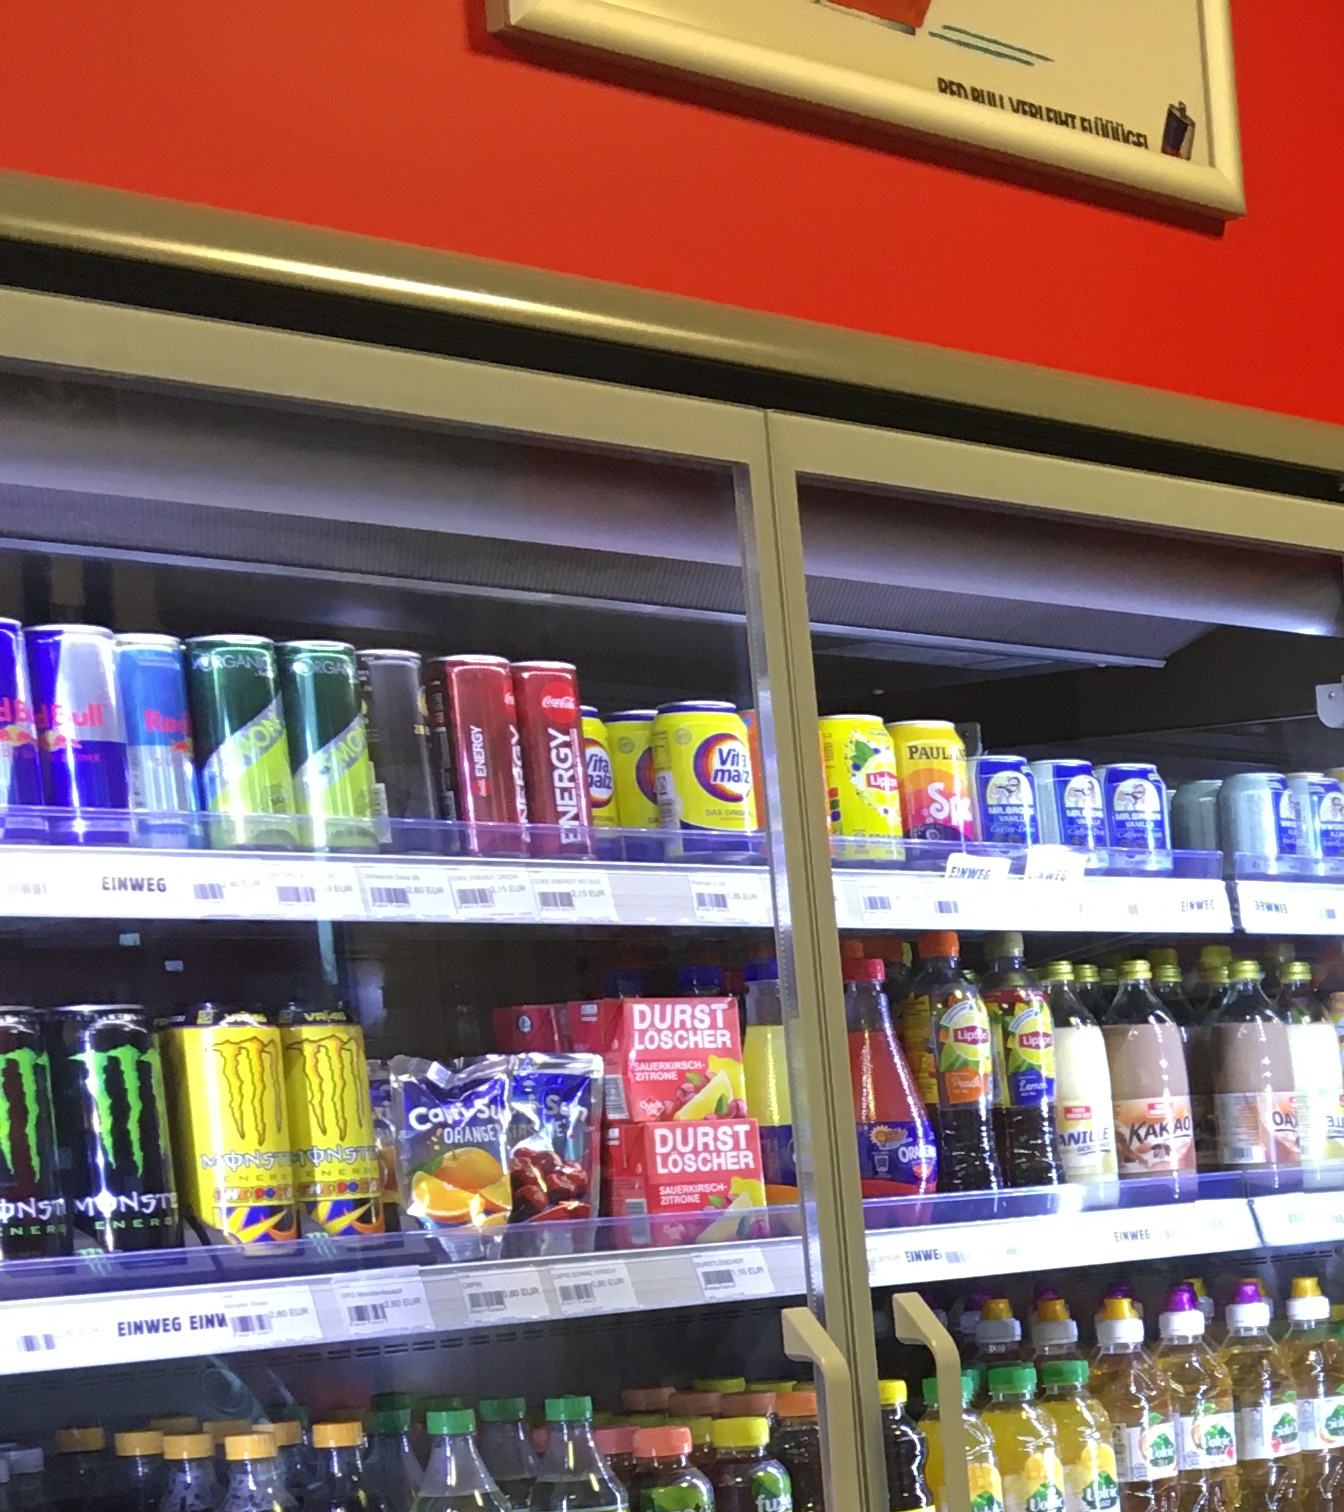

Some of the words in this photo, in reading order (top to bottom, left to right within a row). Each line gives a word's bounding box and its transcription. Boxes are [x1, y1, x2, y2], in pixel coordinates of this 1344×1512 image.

[472, 725, 487, 778] ENERGY
[547, 728, 582, 845] ENERGY
[102, 875, 167, 893] EINWEG
[633, 1003, 726, 1029] DURST
[634, 1027, 731, 1050] LÖSCHER
[633, 1060, 706, 1072] SAUERKIRSCH-
[634, 1071, 678, 1082] ZITRONE
[655, 1125, 751, 1154] DURST
[1129, 1116, 1192, 1145] KAKAO
[656, 1150, 755, 1174] LÖSCHER
[658, 1183, 729, 1196] SAUERKIRSCH-
[659, 1193, 701, 1205] ZITRONE
[1114, 1228, 1150, 1243] EINWEG
